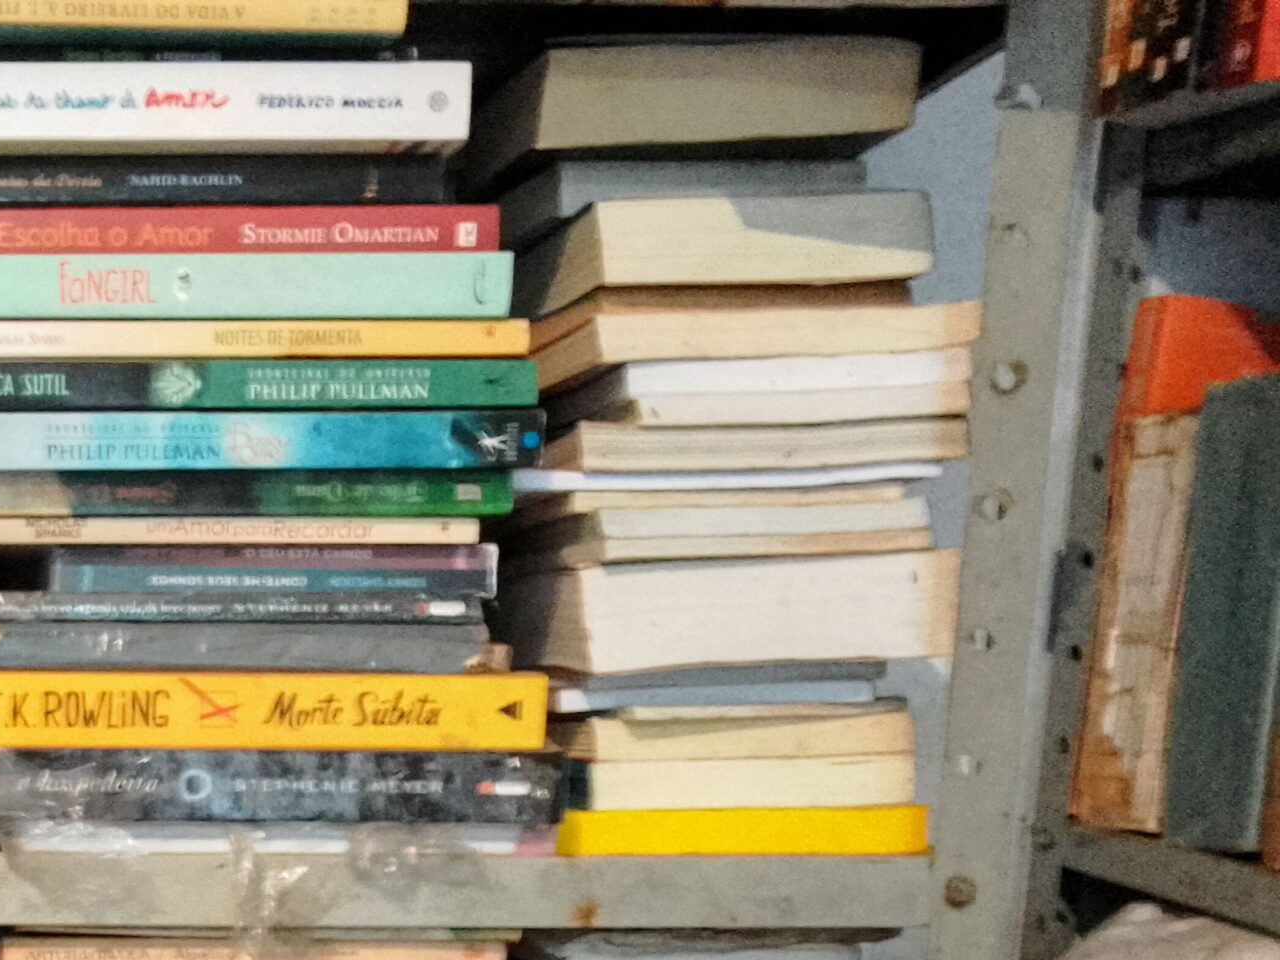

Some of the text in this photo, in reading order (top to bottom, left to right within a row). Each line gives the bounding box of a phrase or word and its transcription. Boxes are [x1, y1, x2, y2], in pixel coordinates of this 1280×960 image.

[187, 2, 229, 20] VIDA
[108, 227, 128, 247] o
[135, 222, 216, 247] Amor
[215, 328, 265, 347] NOITES
[268, 328, 286, 347] DE
[288, 328, 363, 347] TORMENTA
[21, 373, 70, 397] SUTIL
[247, 382, 320, 401] PHILIP
[327, 382, 430, 400] PULLMAN
[46, 443, 118, 461] PHILIP
[123, 442, 221, 460] PULLMAN
[263, 690, 345, 731] Morte
